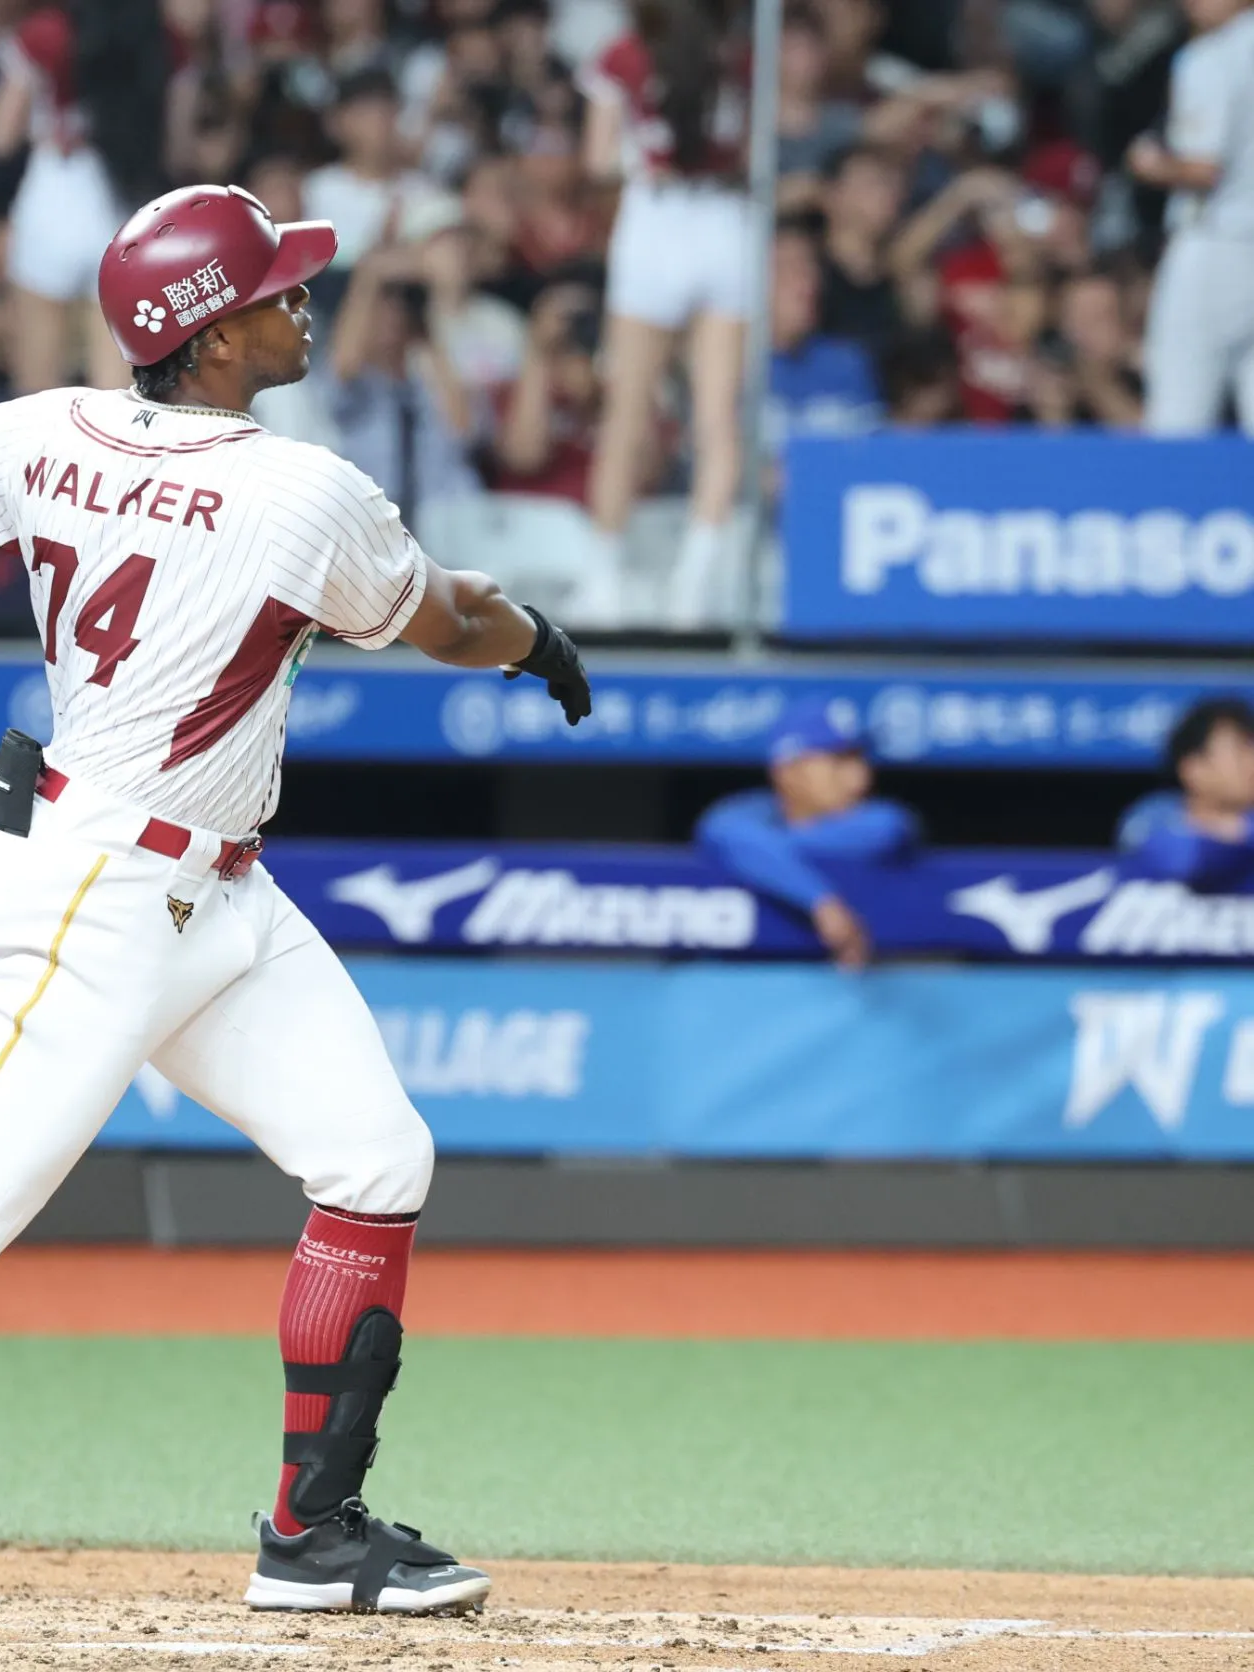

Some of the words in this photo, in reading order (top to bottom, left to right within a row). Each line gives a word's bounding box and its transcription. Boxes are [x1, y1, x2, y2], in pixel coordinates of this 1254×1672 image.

[162, 258, 228, 311] 聯新
[25, 456, 223, 531] WALKER
[841, 484, 1254, 597] Panaso
[32, 535, 157, 688] 74
[461, 868, 757, 949] Mizuno
[301, 1233, 386, 1265] Rakuten
